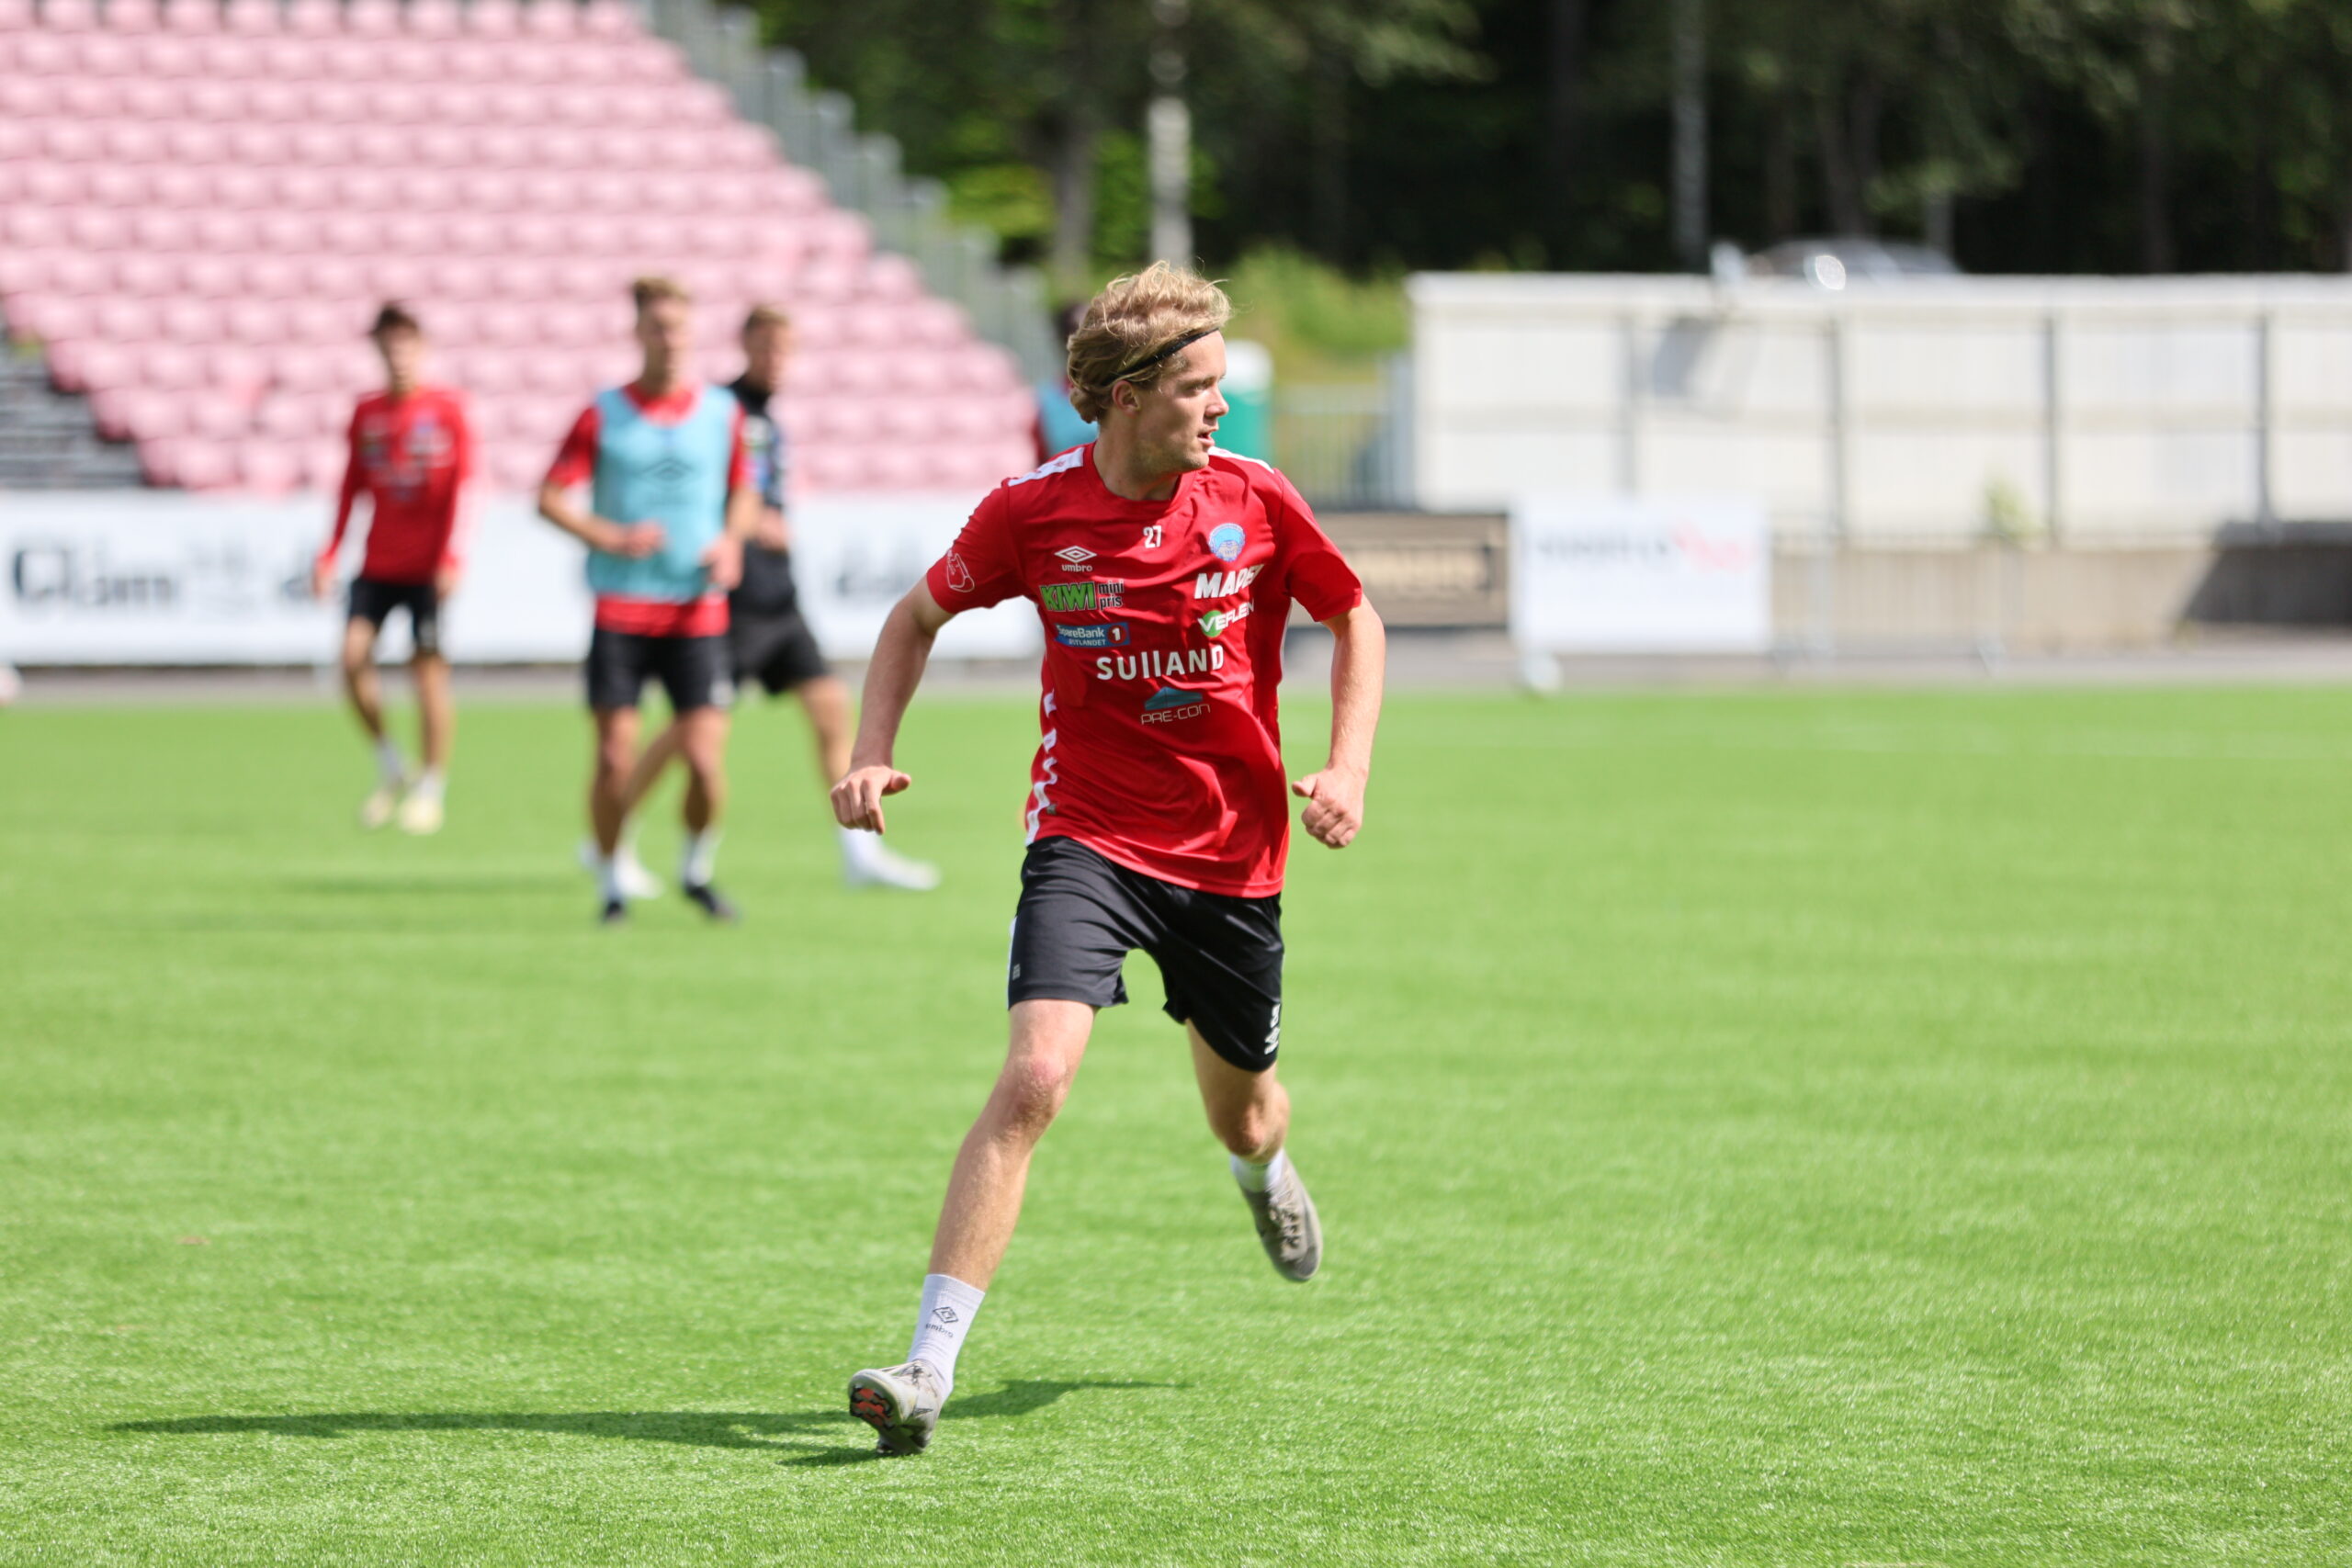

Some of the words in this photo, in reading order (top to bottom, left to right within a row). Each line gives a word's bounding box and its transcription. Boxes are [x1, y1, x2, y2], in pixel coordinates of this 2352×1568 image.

[1143, 525, 1162, 548] 27
[1061, 563, 1093, 572] umbro
[1098, 580, 1125, 594] mini
[1039, 581, 1097, 612] KIWI
[1099, 594, 1123, 611] pris
[1112, 627, 1122, 641] 1
[925, 1322, 955, 1338] umbro
